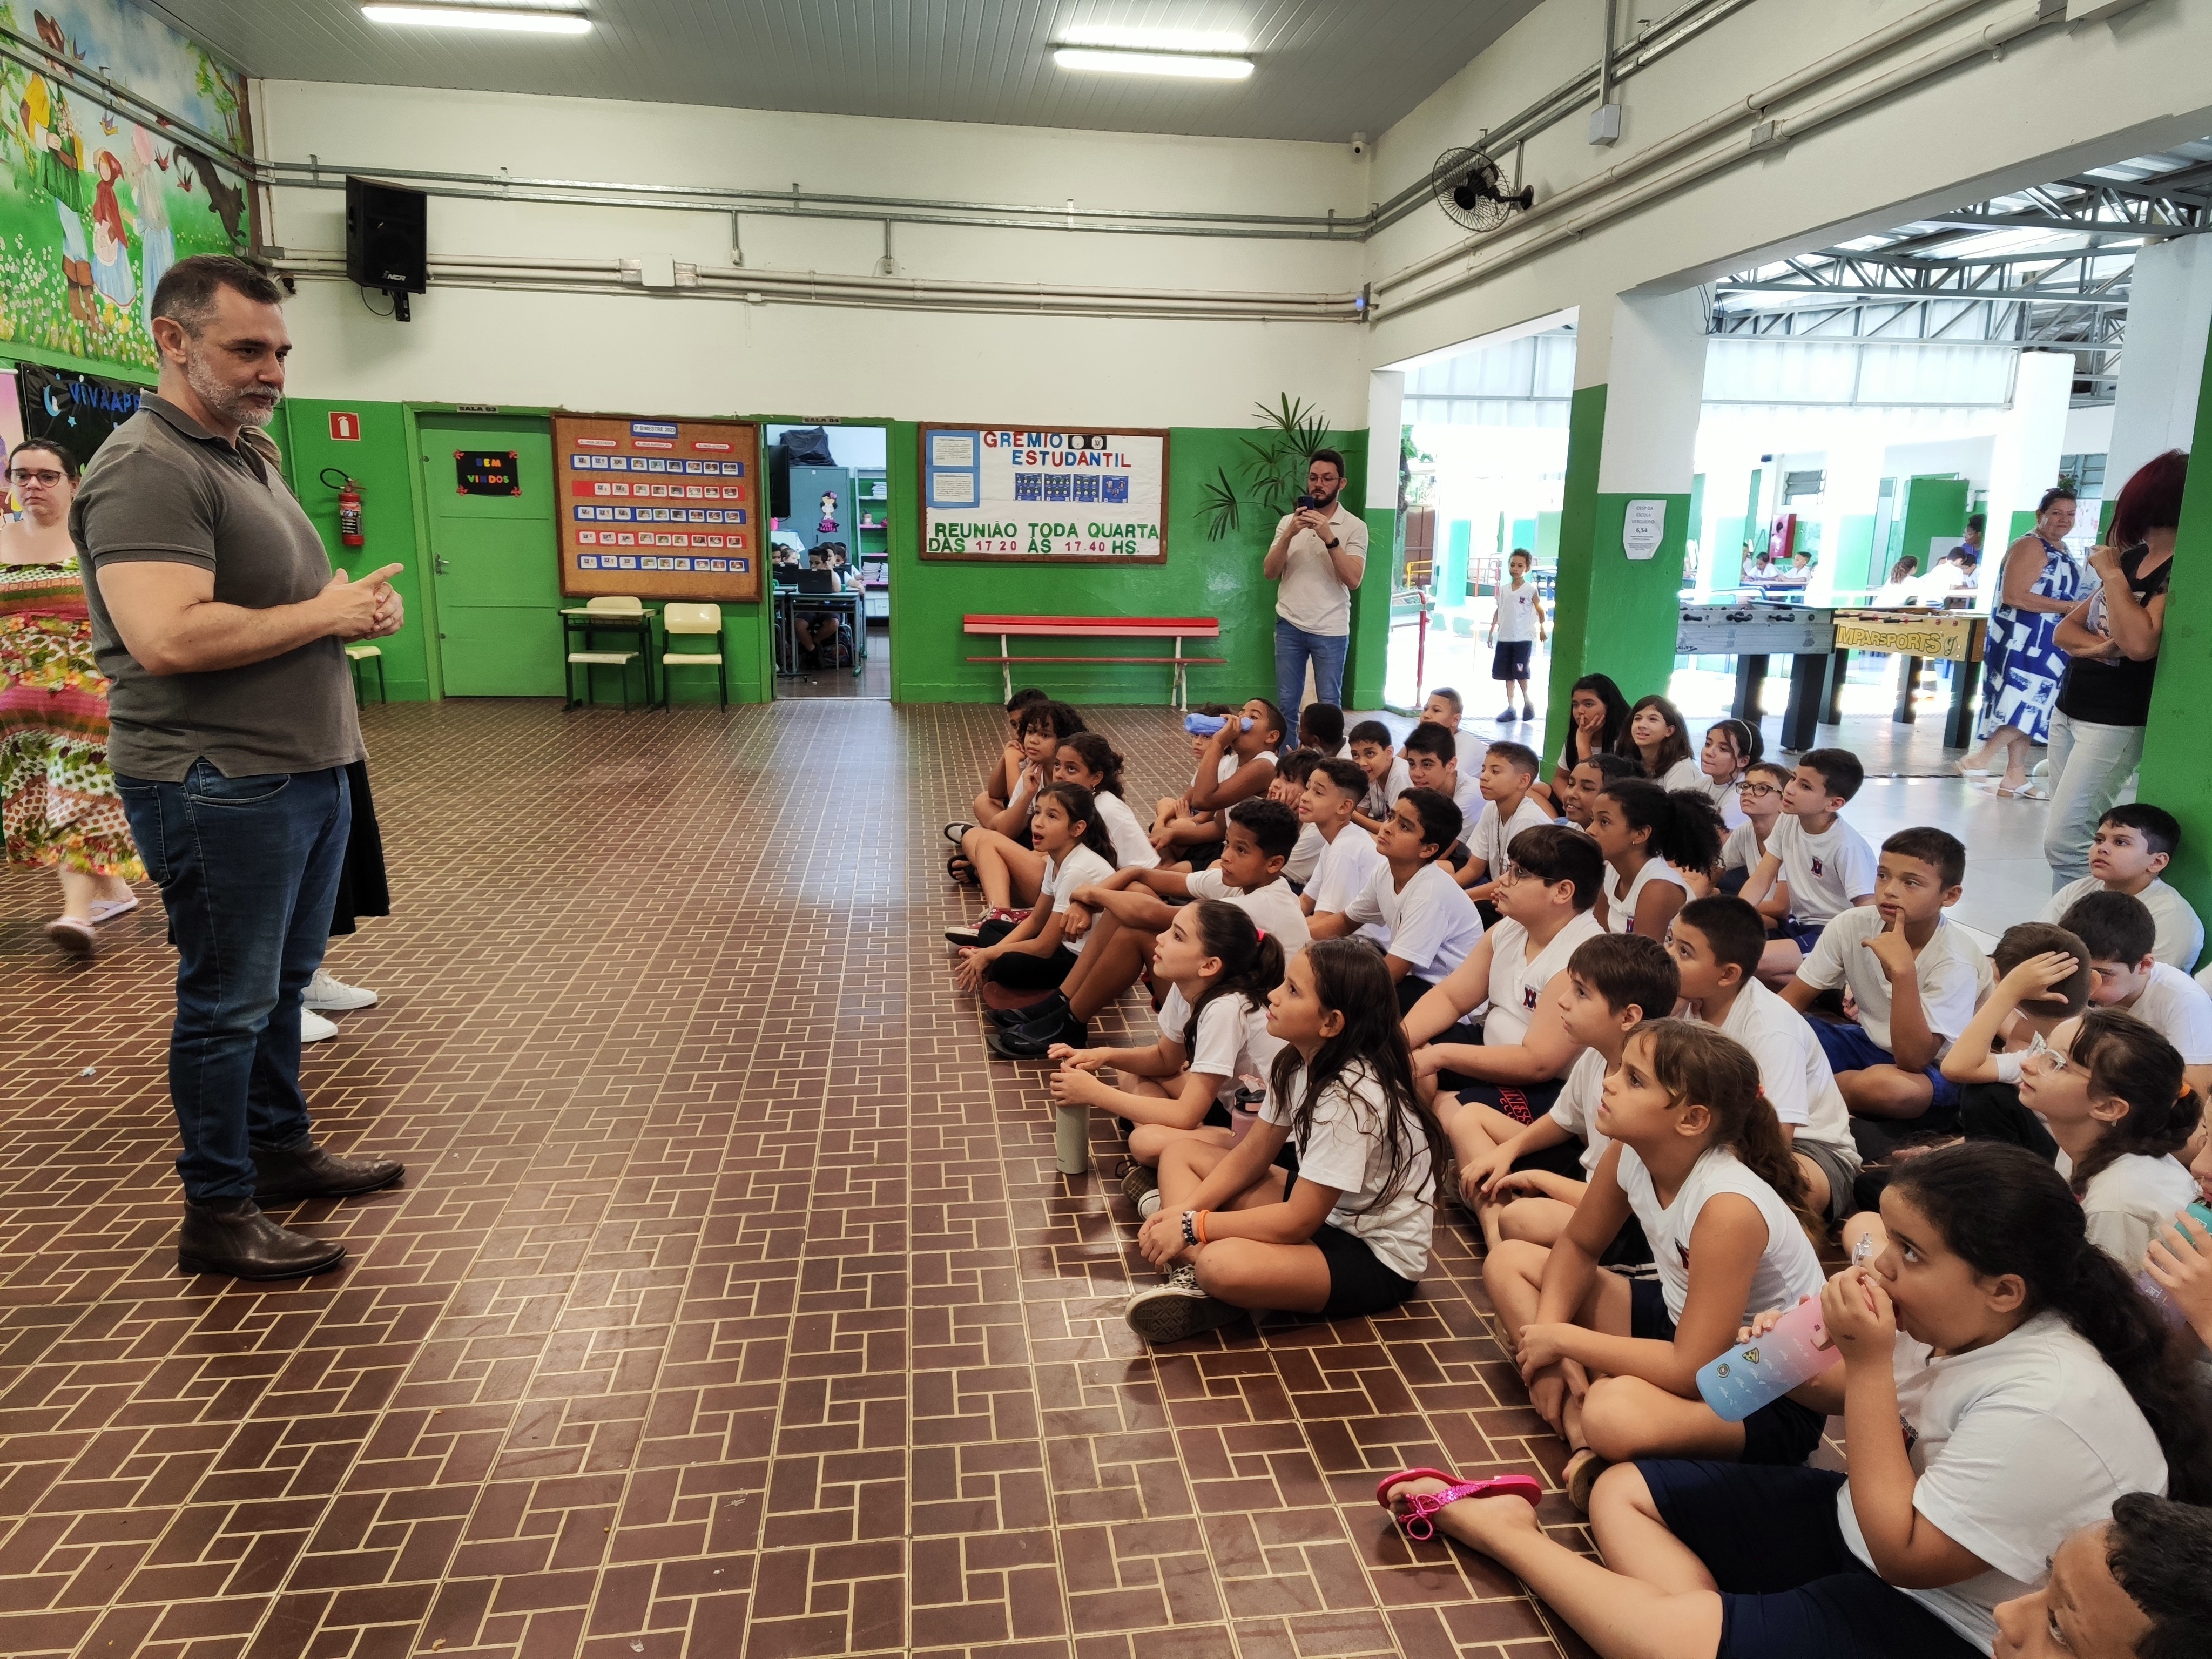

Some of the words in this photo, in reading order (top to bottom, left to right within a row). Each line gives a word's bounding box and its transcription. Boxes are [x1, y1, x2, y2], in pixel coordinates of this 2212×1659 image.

[476, 458, 501, 467] BEM
[1012, 450, 1132, 467] ESTUDANTIL
[467, 475, 509, 483] VINDOS
[935, 521, 1017, 538] REUNIÃO
[1028, 522, 1078, 538] TODA
[1088, 522, 1159, 539] QUARTA
[928, 537, 966, 553] DAS
